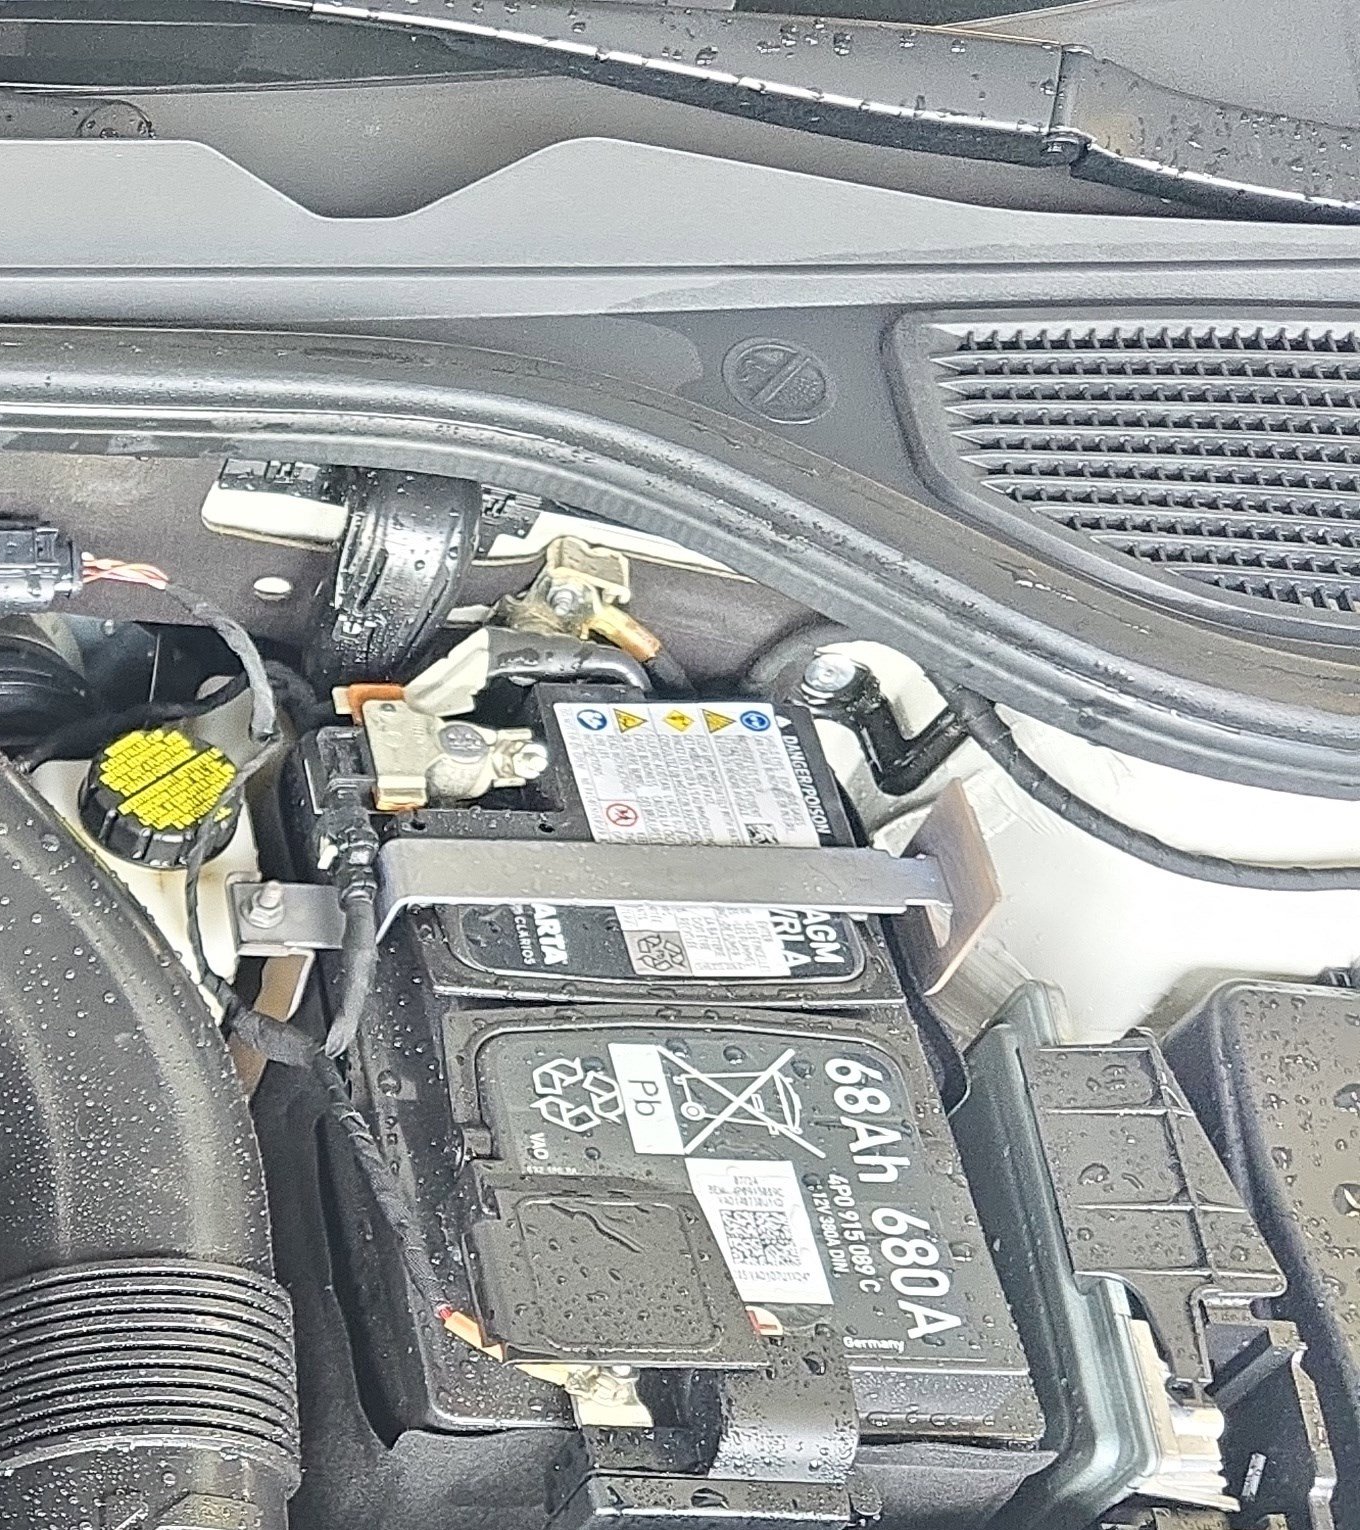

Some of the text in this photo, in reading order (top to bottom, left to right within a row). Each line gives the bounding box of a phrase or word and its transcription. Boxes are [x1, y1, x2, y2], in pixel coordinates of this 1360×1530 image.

[781, 734, 831, 836] DANGER/POISON
[514, 916, 536, 965] CLARIOS
[532, 903, 569, 966] ARTA
[803, 908, 845, 965] AGM
[628, 1079, 662, 1116] Pb
[811, 1191, 831, 1216] 12V
[825, 1057, 962, 1340] 68Ah 680A
[819, 1215, 841, 1247] 380A
[837, 1208, 865, 1243] 915
[848, 1244, 876, 1279] 089
[859, 1279, 881, 1294] C
[842, 1336, 905, 1354] Germany
